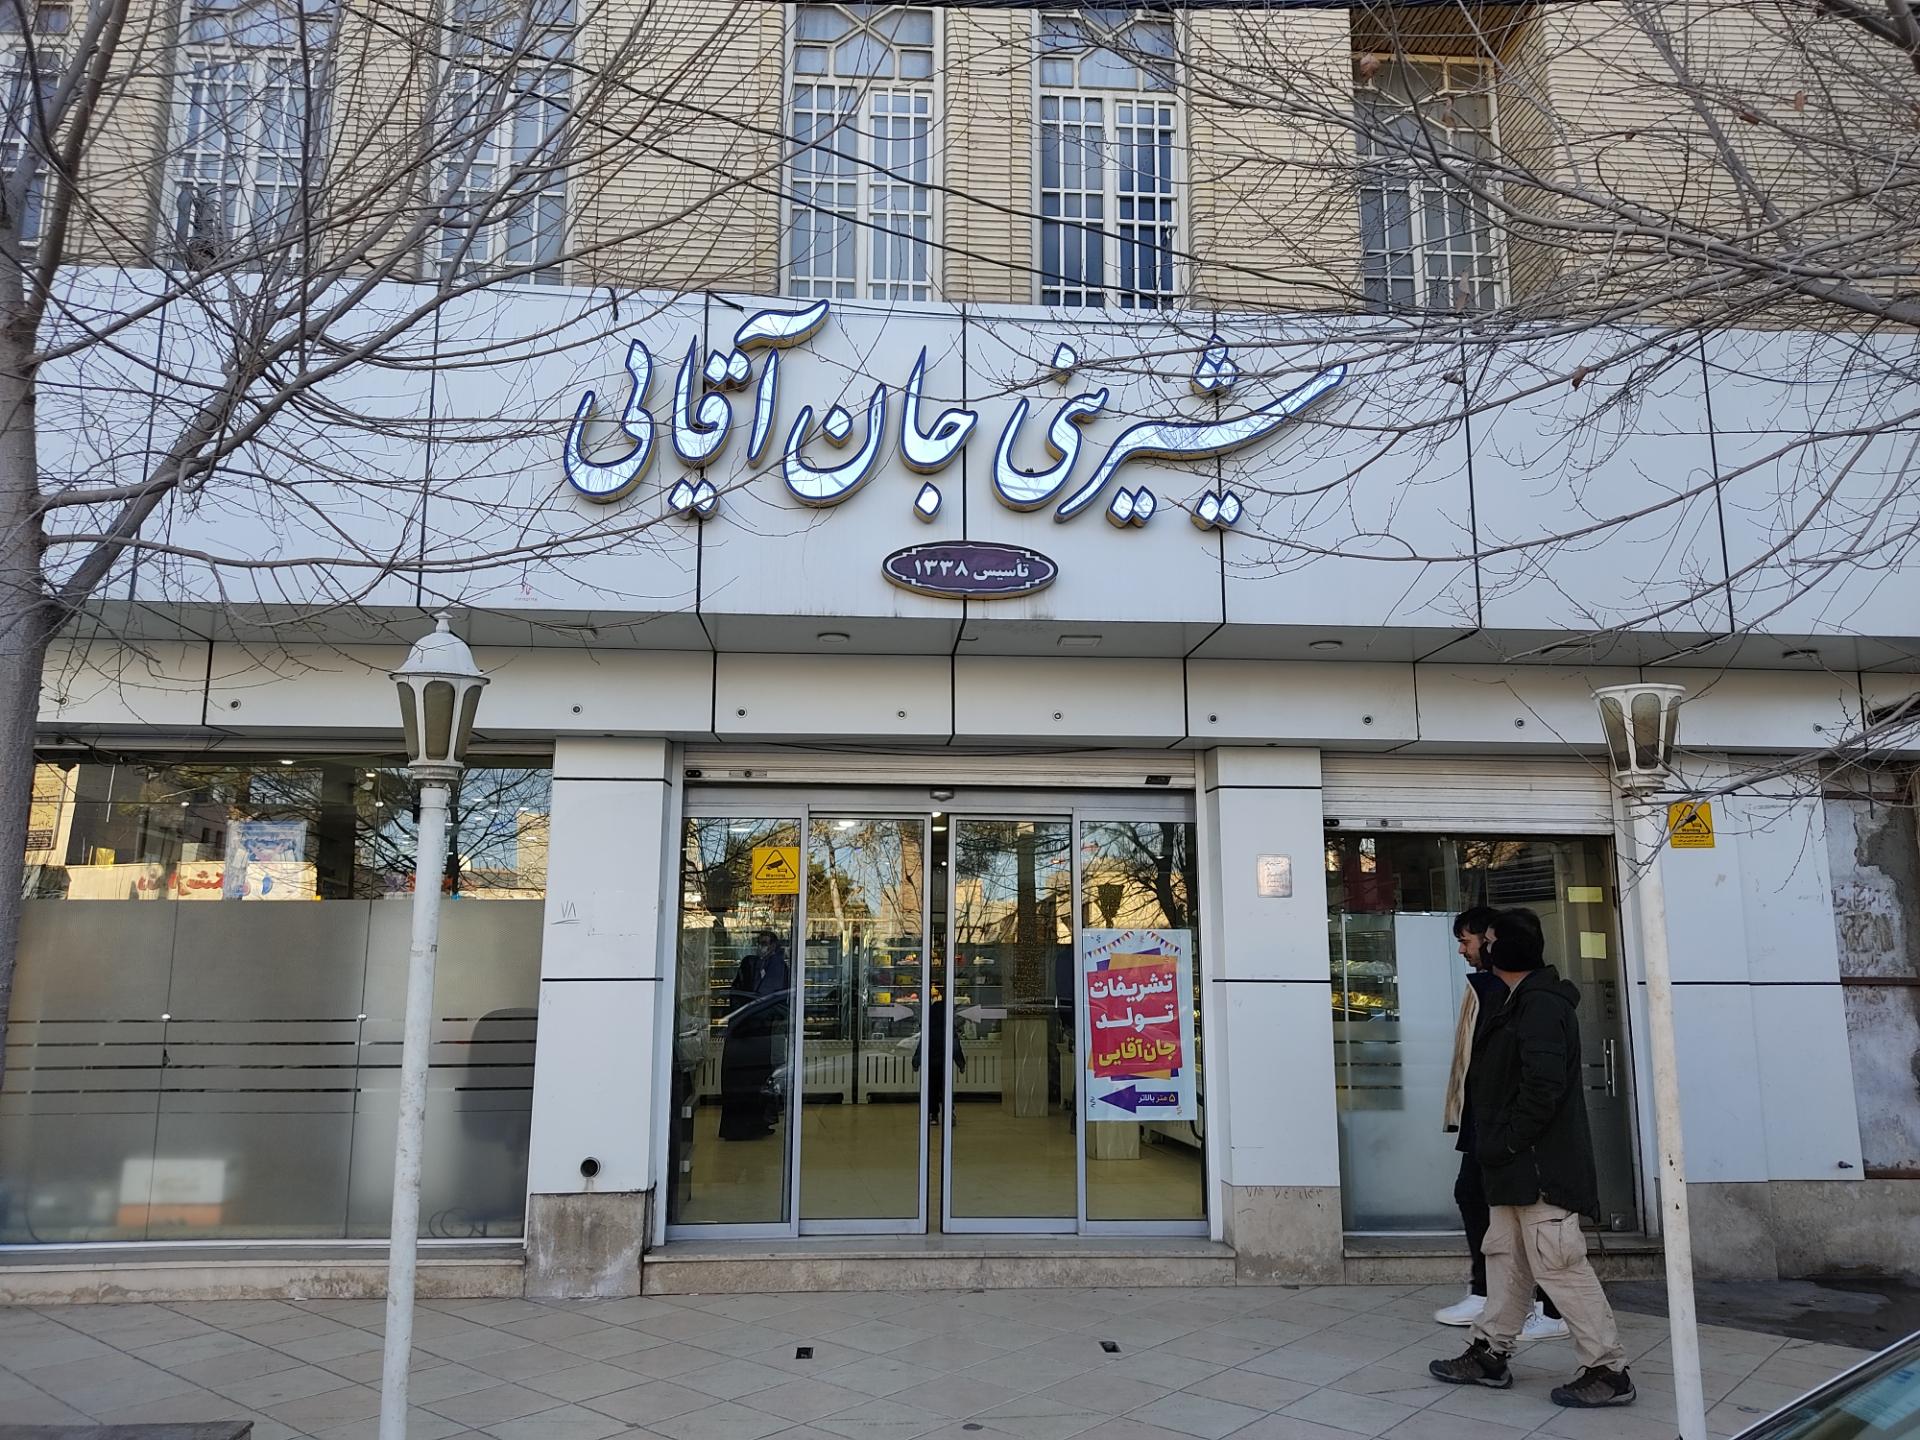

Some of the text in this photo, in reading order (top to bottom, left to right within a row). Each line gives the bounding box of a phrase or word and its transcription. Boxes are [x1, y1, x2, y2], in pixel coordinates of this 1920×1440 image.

[782, 345, 979, 523] جان
[992, 334, 1348, 528] شیرینی
[914, 558, 1029, 581] تأسیس ۱۳۳۸
[1090, 973, 1173, 1001] تشریفات
[1096, 1004, 1174, 1032] تولد
[1169, 1094, 1176, 1103] ۵
